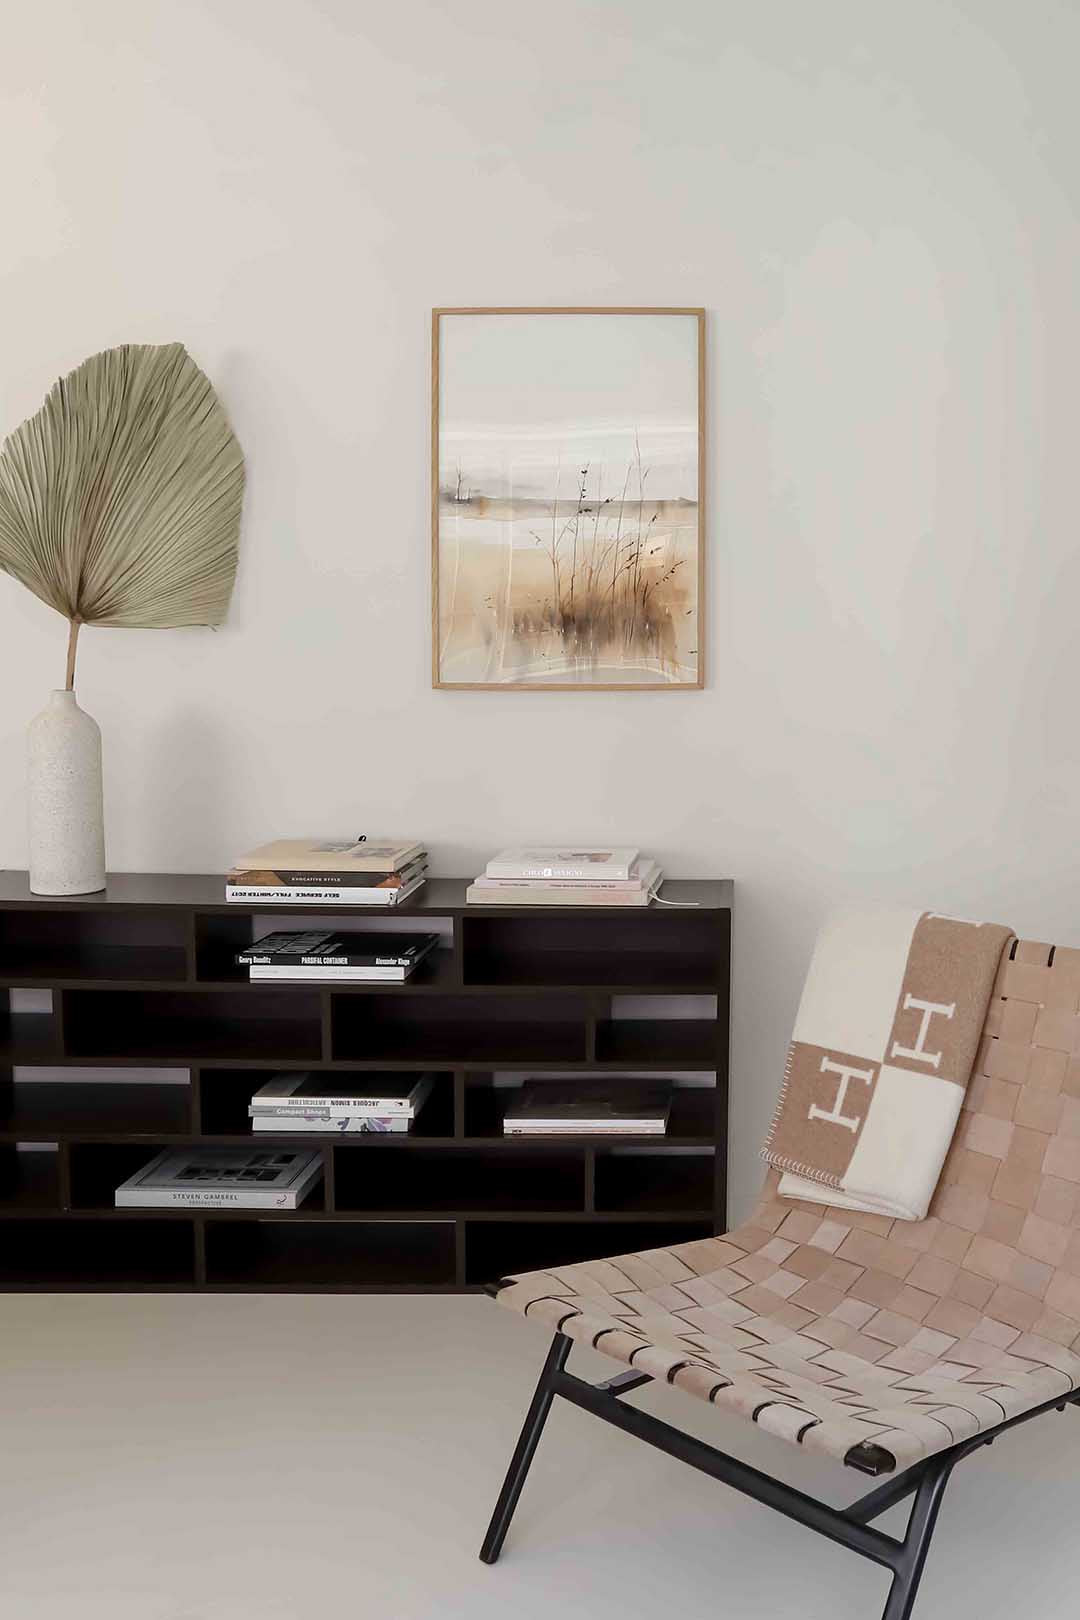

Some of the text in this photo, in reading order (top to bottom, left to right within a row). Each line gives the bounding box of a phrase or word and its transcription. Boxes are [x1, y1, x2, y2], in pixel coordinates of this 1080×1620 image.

[238, 956, 253, 965] Georg
[301, 956, 348, 965] PARSIFAL CONTAINER
[375, 957, 397, 965] Alexander
[891, 993, 956, 1069] H
[807, 1056, 875, 1134] H
